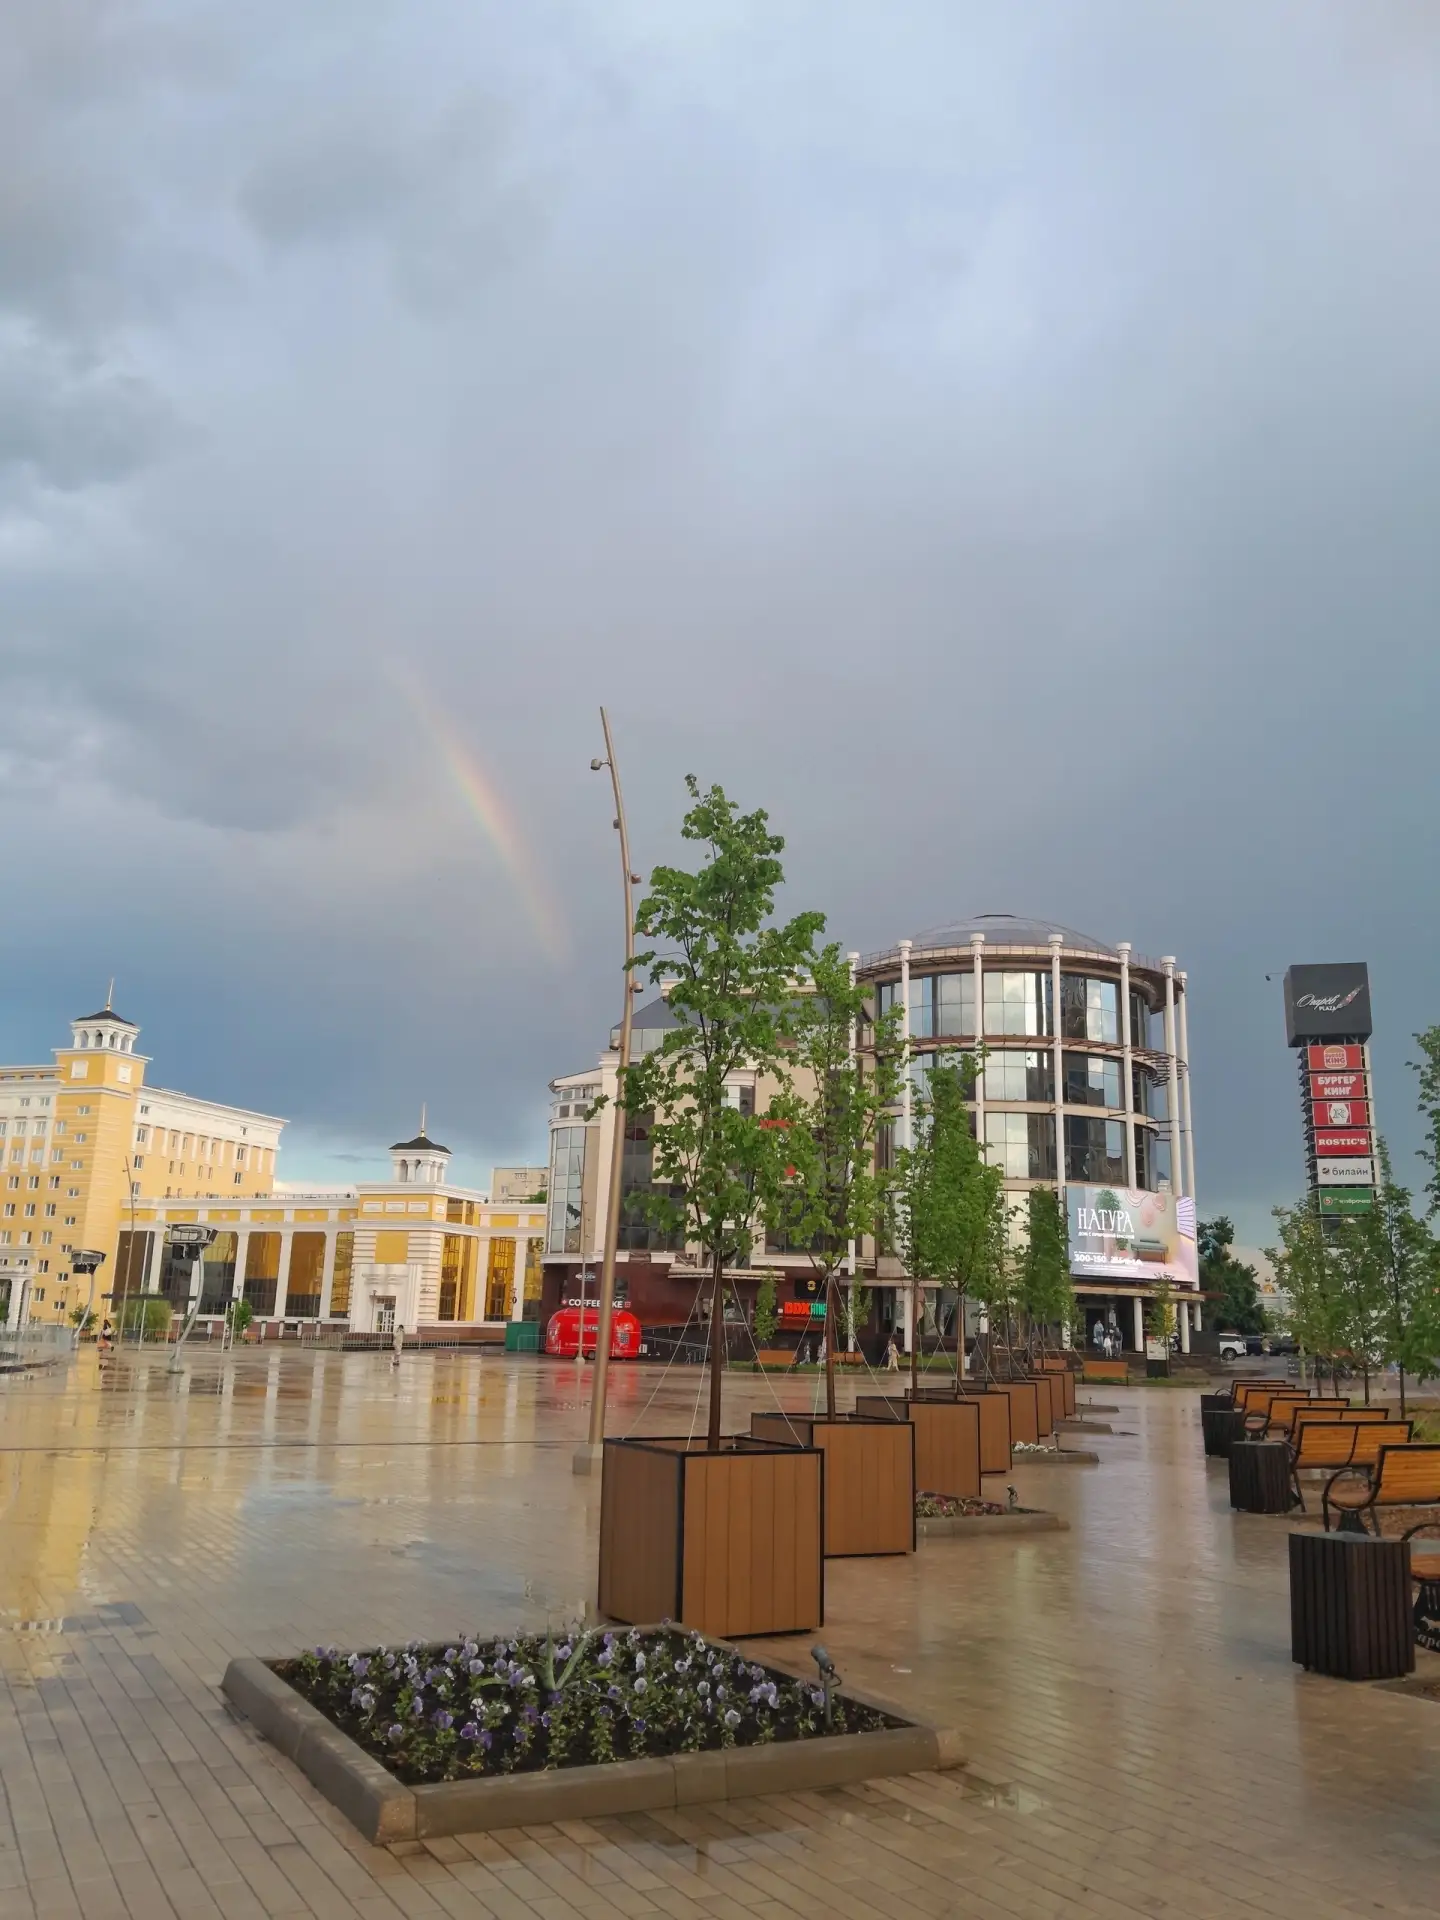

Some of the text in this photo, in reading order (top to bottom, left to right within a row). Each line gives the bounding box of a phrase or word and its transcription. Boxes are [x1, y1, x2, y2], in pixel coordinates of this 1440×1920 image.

[1325, 1057, 1346, 1065] KING
[1317, 1075, 1357, 1085] БУРГЕР
[1323, 1086, 1352, 1096] КИНГ
[1318, 1138, 1368, 1146] ROSTIC'S
[1331, 1167, 1369, 1176] билайн
[1077, 1208, 1135, 1233] НАТУРА
